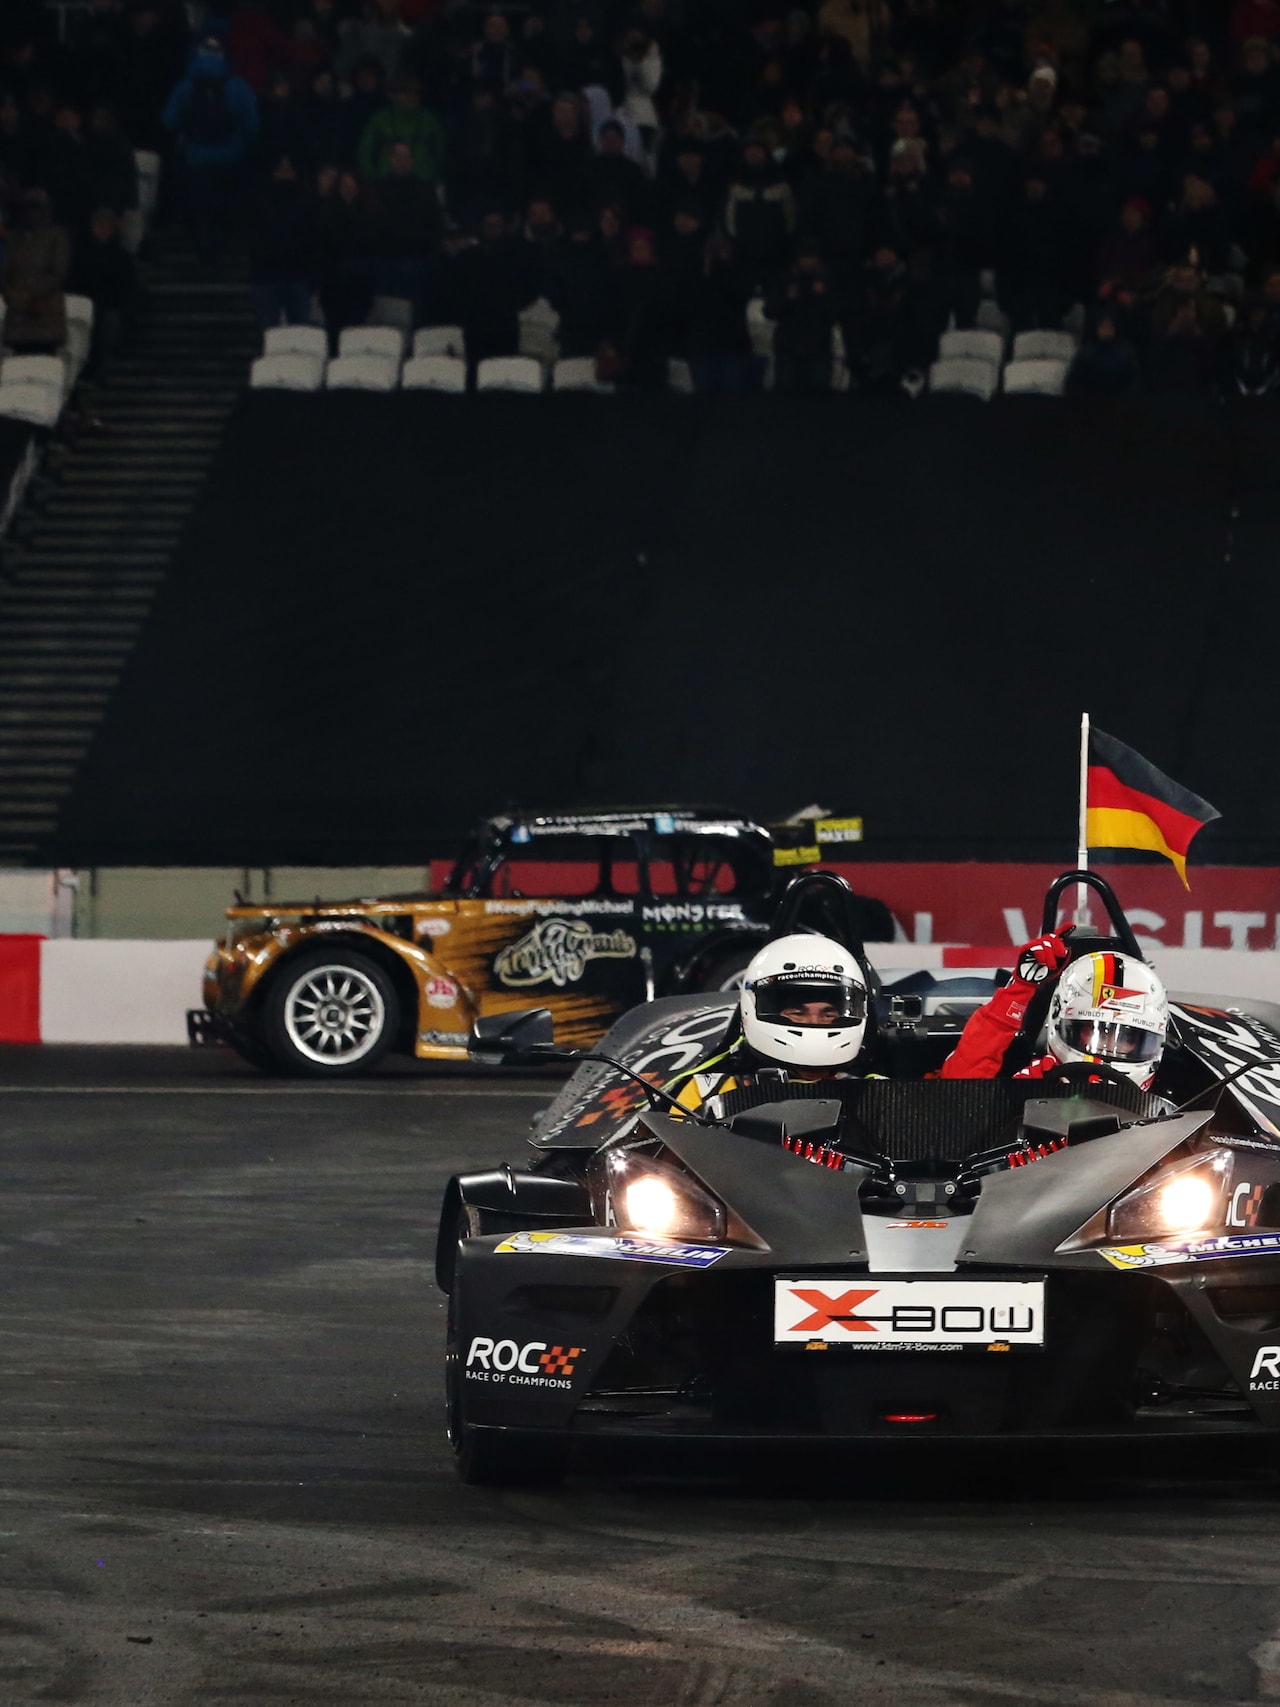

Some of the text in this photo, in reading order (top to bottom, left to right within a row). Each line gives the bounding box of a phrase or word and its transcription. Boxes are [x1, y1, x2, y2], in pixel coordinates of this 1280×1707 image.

[1077, 1010, 1105, 1018] HUBLOT
[620, 1003, 738, 1081] OC
[466, 1336, 548, 1374] ROC
[465, 1370, 573, 1390] RACE OF CHAMPIONS
[1249, 1380, 1280, 1391] RACE
